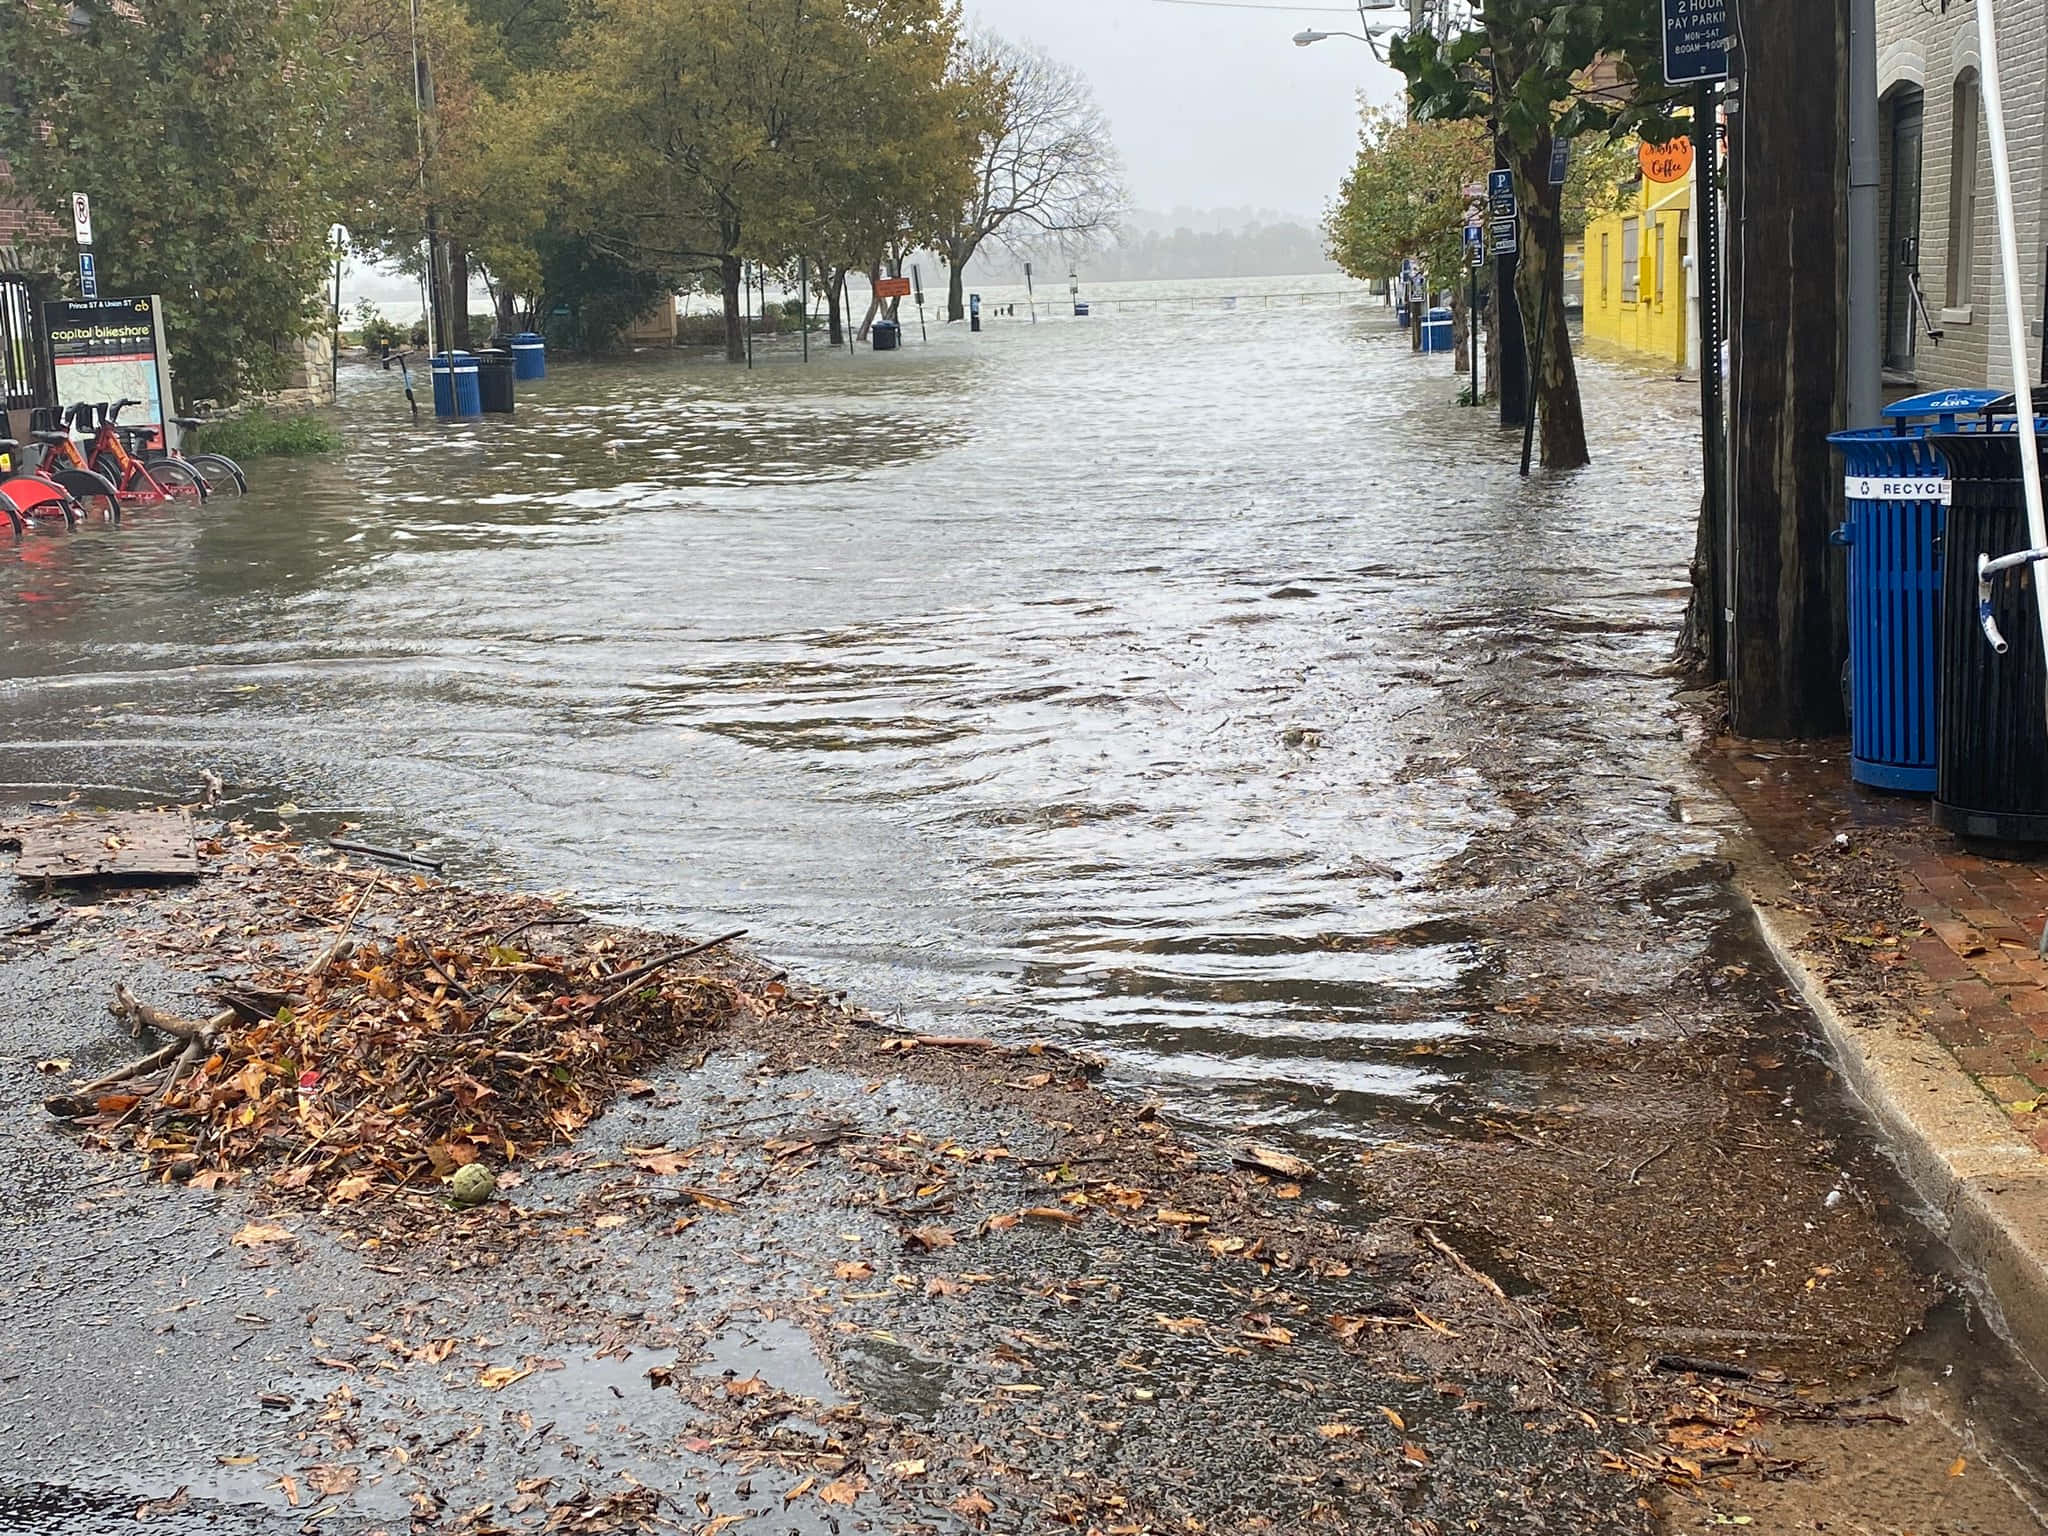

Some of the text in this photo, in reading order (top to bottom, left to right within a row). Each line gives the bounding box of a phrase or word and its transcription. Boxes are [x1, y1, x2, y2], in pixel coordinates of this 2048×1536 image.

[1678, 0, 1724, 13] 2 HOUR
[1667, 16, 1688, 30] PAY
[1652, 159, 1681, 177] Coffee
[1496, 174, 1506, 187] P
[89, 300, 98, 309] ST
[123, 299, 132, 307] ST
[51, 327, 92, 342] capital
[95, 325, 150, 338] bikeshare
